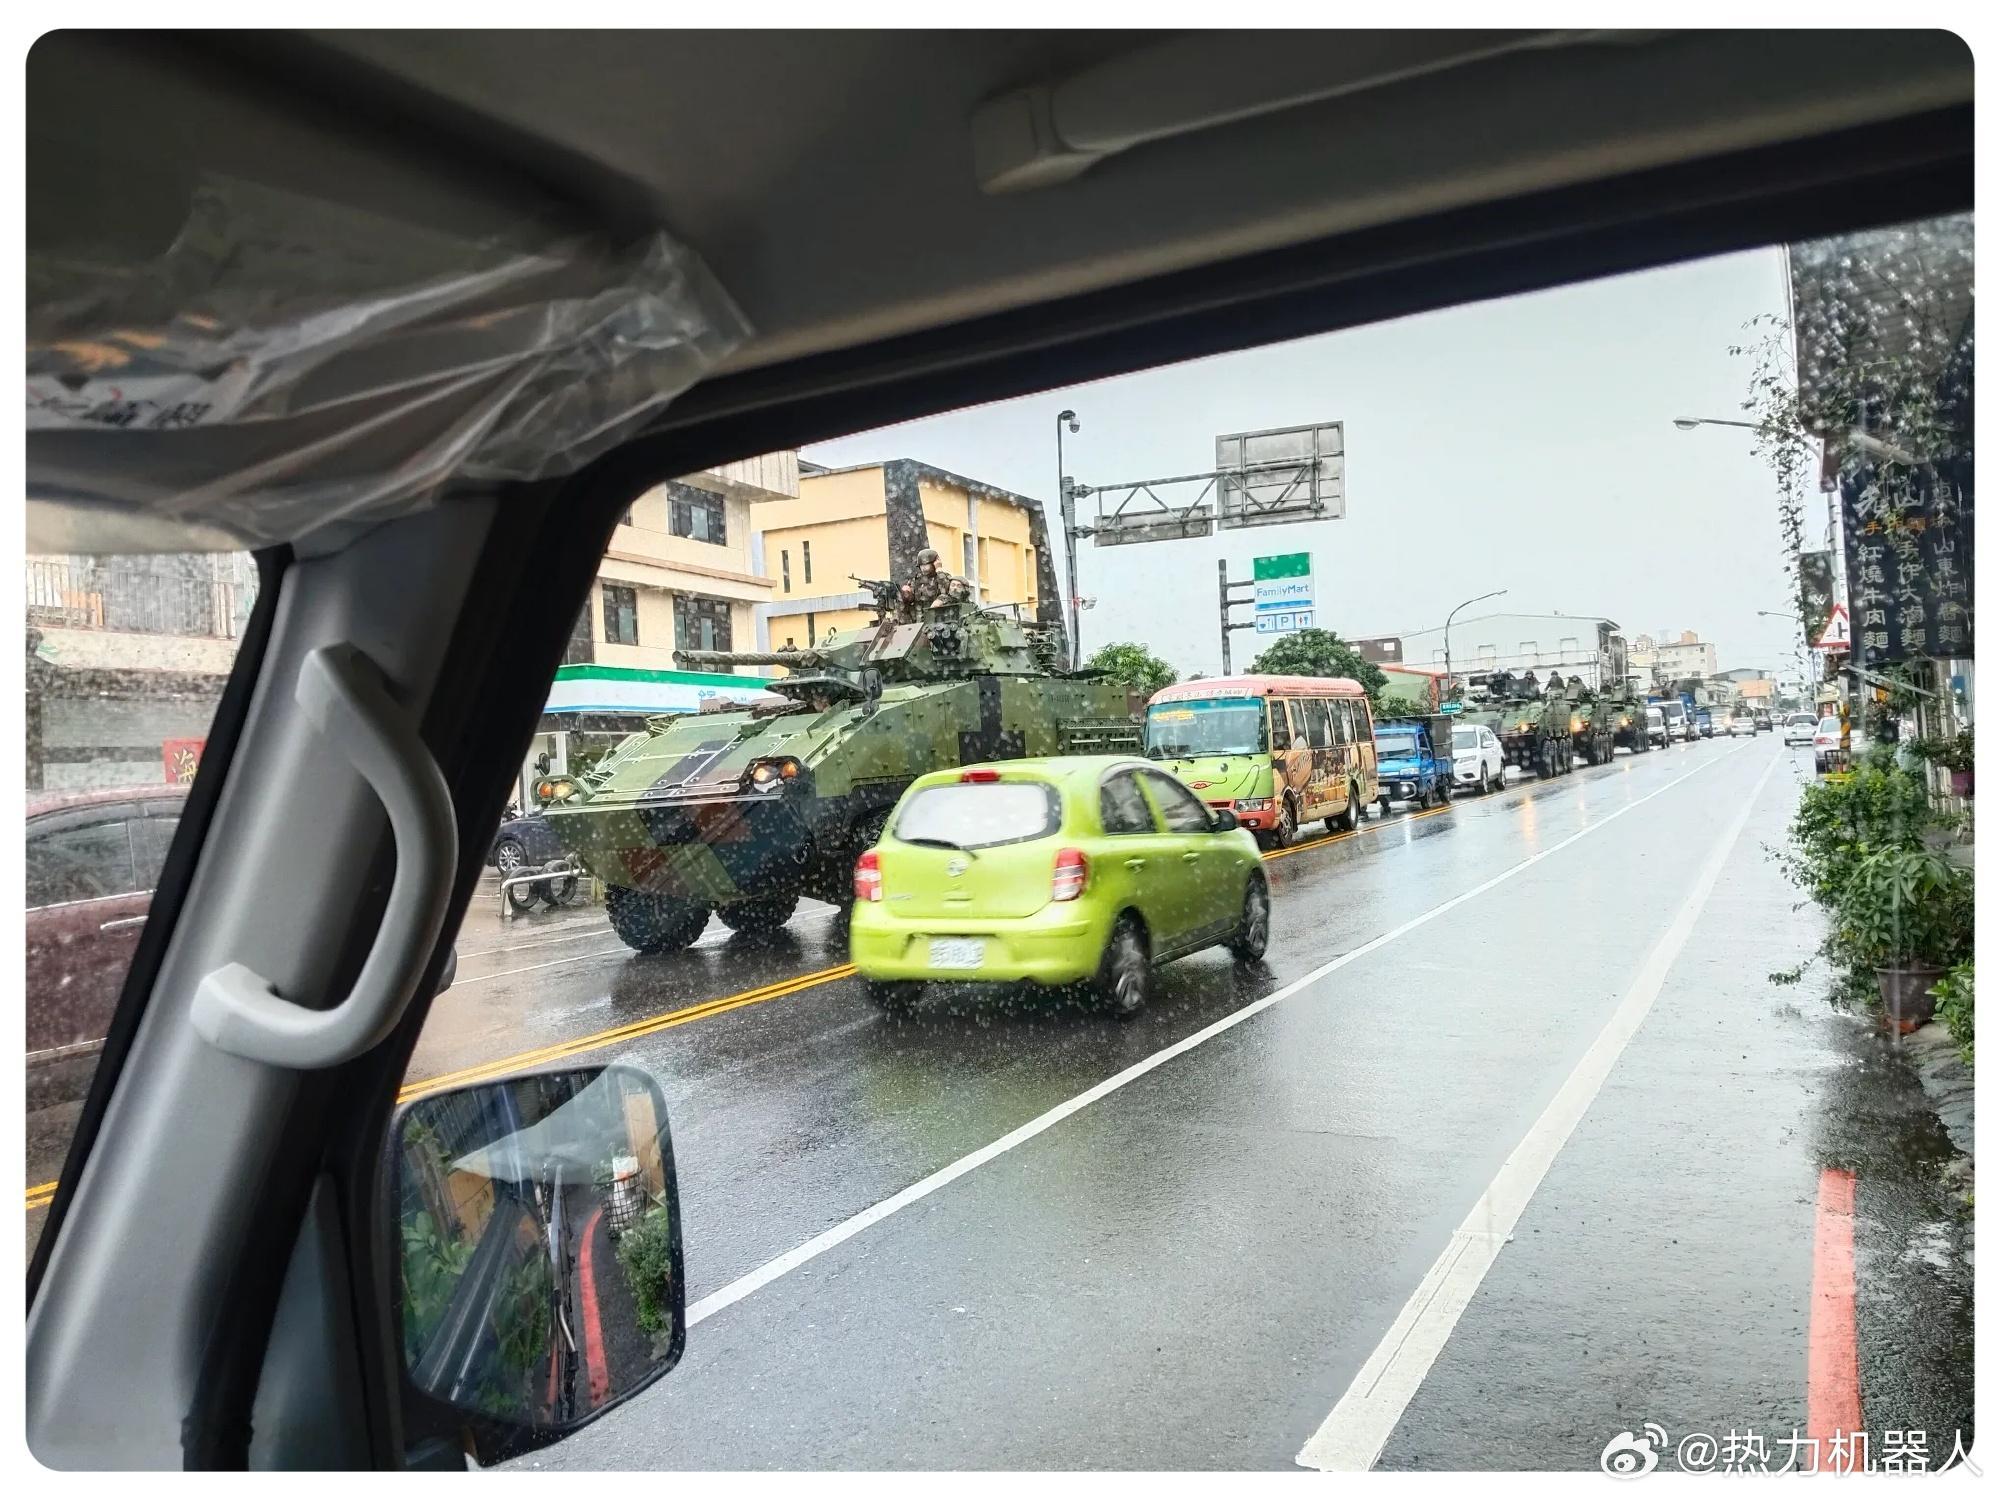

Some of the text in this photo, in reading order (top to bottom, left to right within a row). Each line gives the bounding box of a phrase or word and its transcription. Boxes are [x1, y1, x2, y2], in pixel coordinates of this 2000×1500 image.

[1257, 584, 1309, 597] FamilyMart
[1857, 544, 1889, 649] 紅燒牛肉麵
[1281, 616, 1289, 626] P
